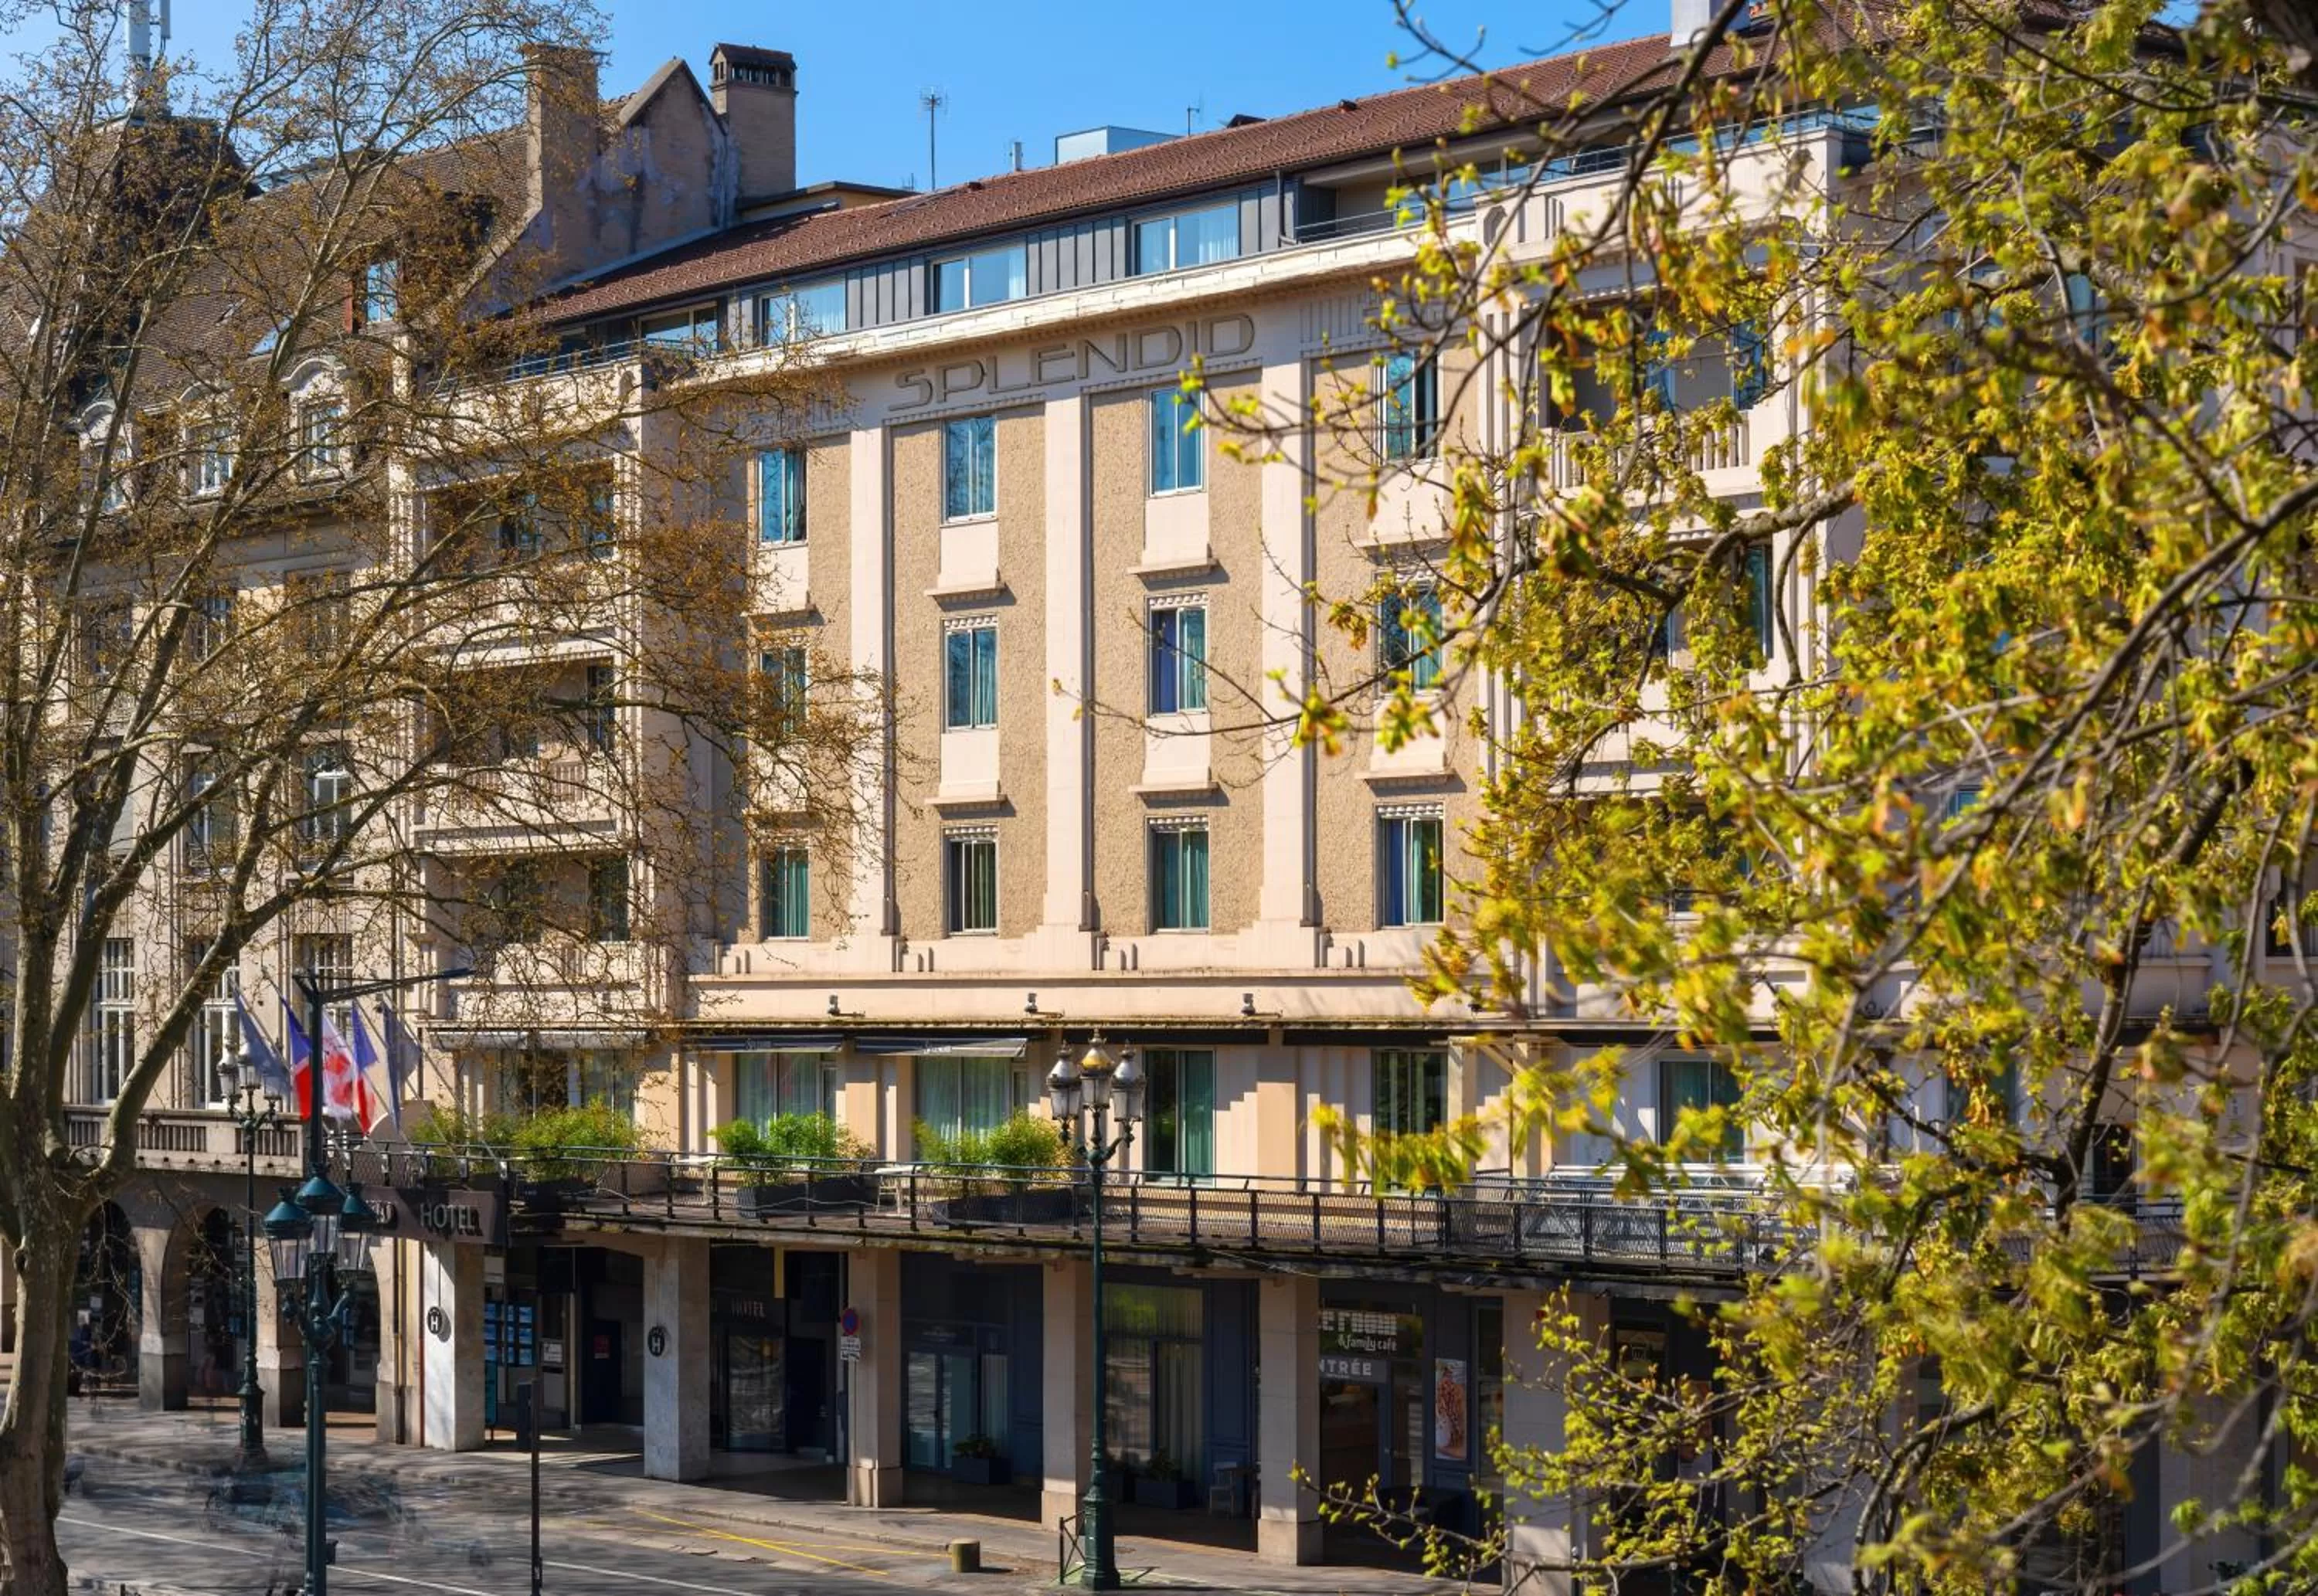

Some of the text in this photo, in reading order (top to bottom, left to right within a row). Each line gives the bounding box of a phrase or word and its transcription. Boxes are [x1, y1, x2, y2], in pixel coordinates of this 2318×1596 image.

[888, 312, 1256, 411] SPLENDID
[420, 1202, 475, 1231] HOTEL
[430, 1316, 438, 1332] H
[1319, 1358, 1372, 1376] NTRÉE
